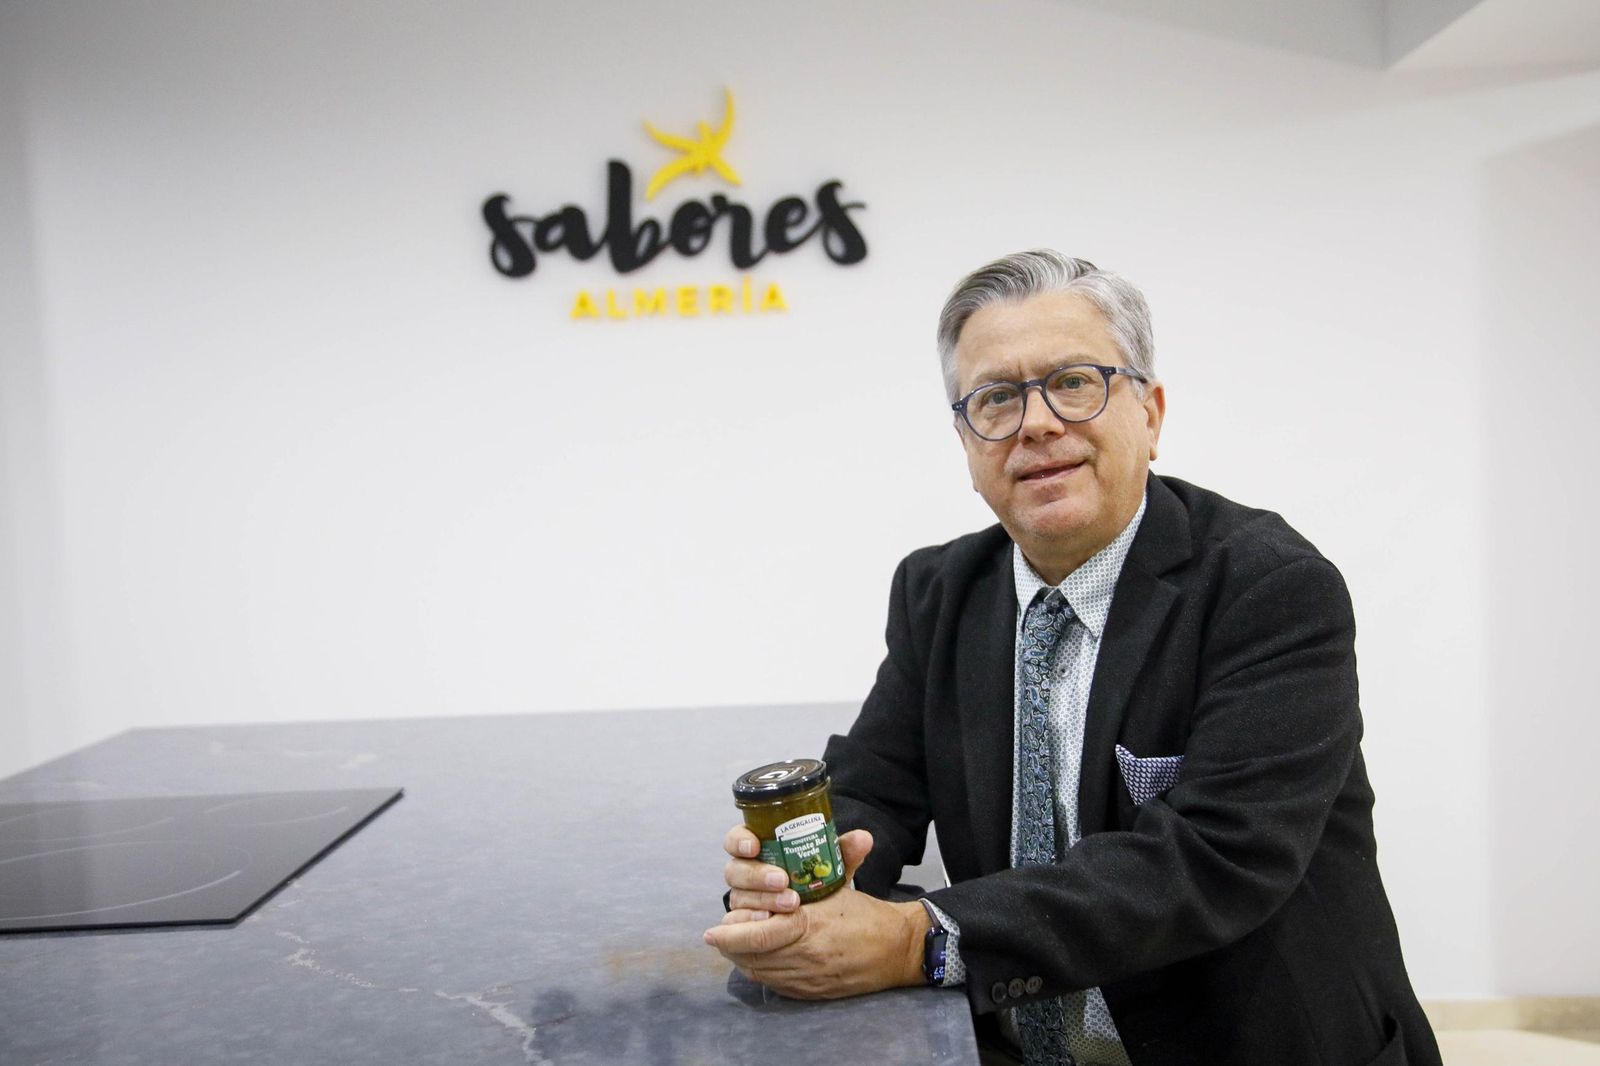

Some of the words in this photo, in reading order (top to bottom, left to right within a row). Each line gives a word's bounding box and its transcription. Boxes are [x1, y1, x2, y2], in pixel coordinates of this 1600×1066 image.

[482, 158, 868, 278] sabores
[570, 274, 789, 320] ALMERÍA
[783, 841, 815, 855] Tomate
[797, 847, 820, 859] Verde
